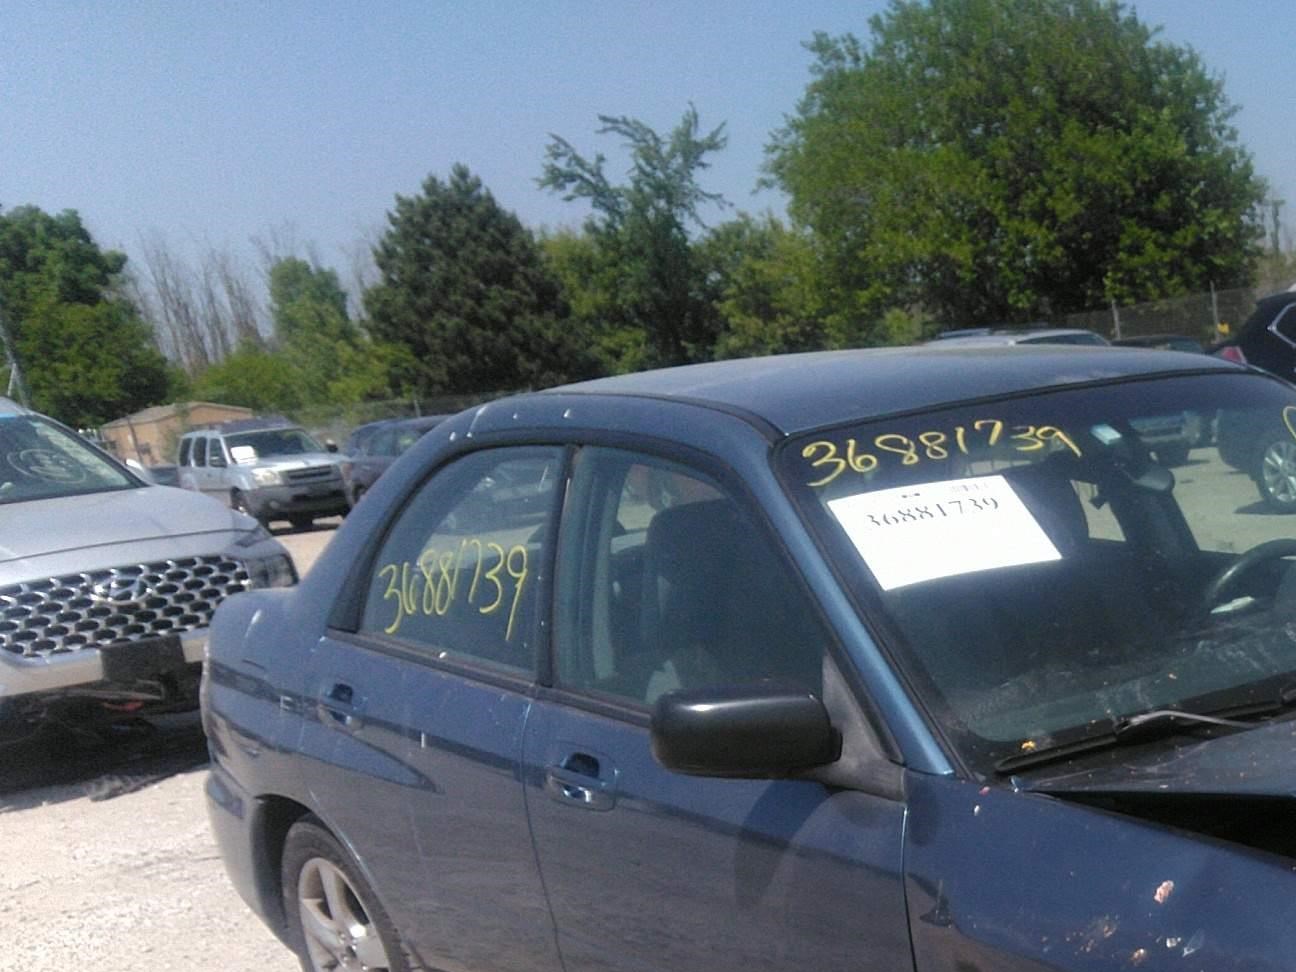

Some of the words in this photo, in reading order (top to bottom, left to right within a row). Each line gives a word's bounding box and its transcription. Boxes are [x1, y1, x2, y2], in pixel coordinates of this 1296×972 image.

[801, 419, 1082, 487] 36881739
[866, 496, 999, 527] 36881739
[378, 538, 529, 641] 36881739
